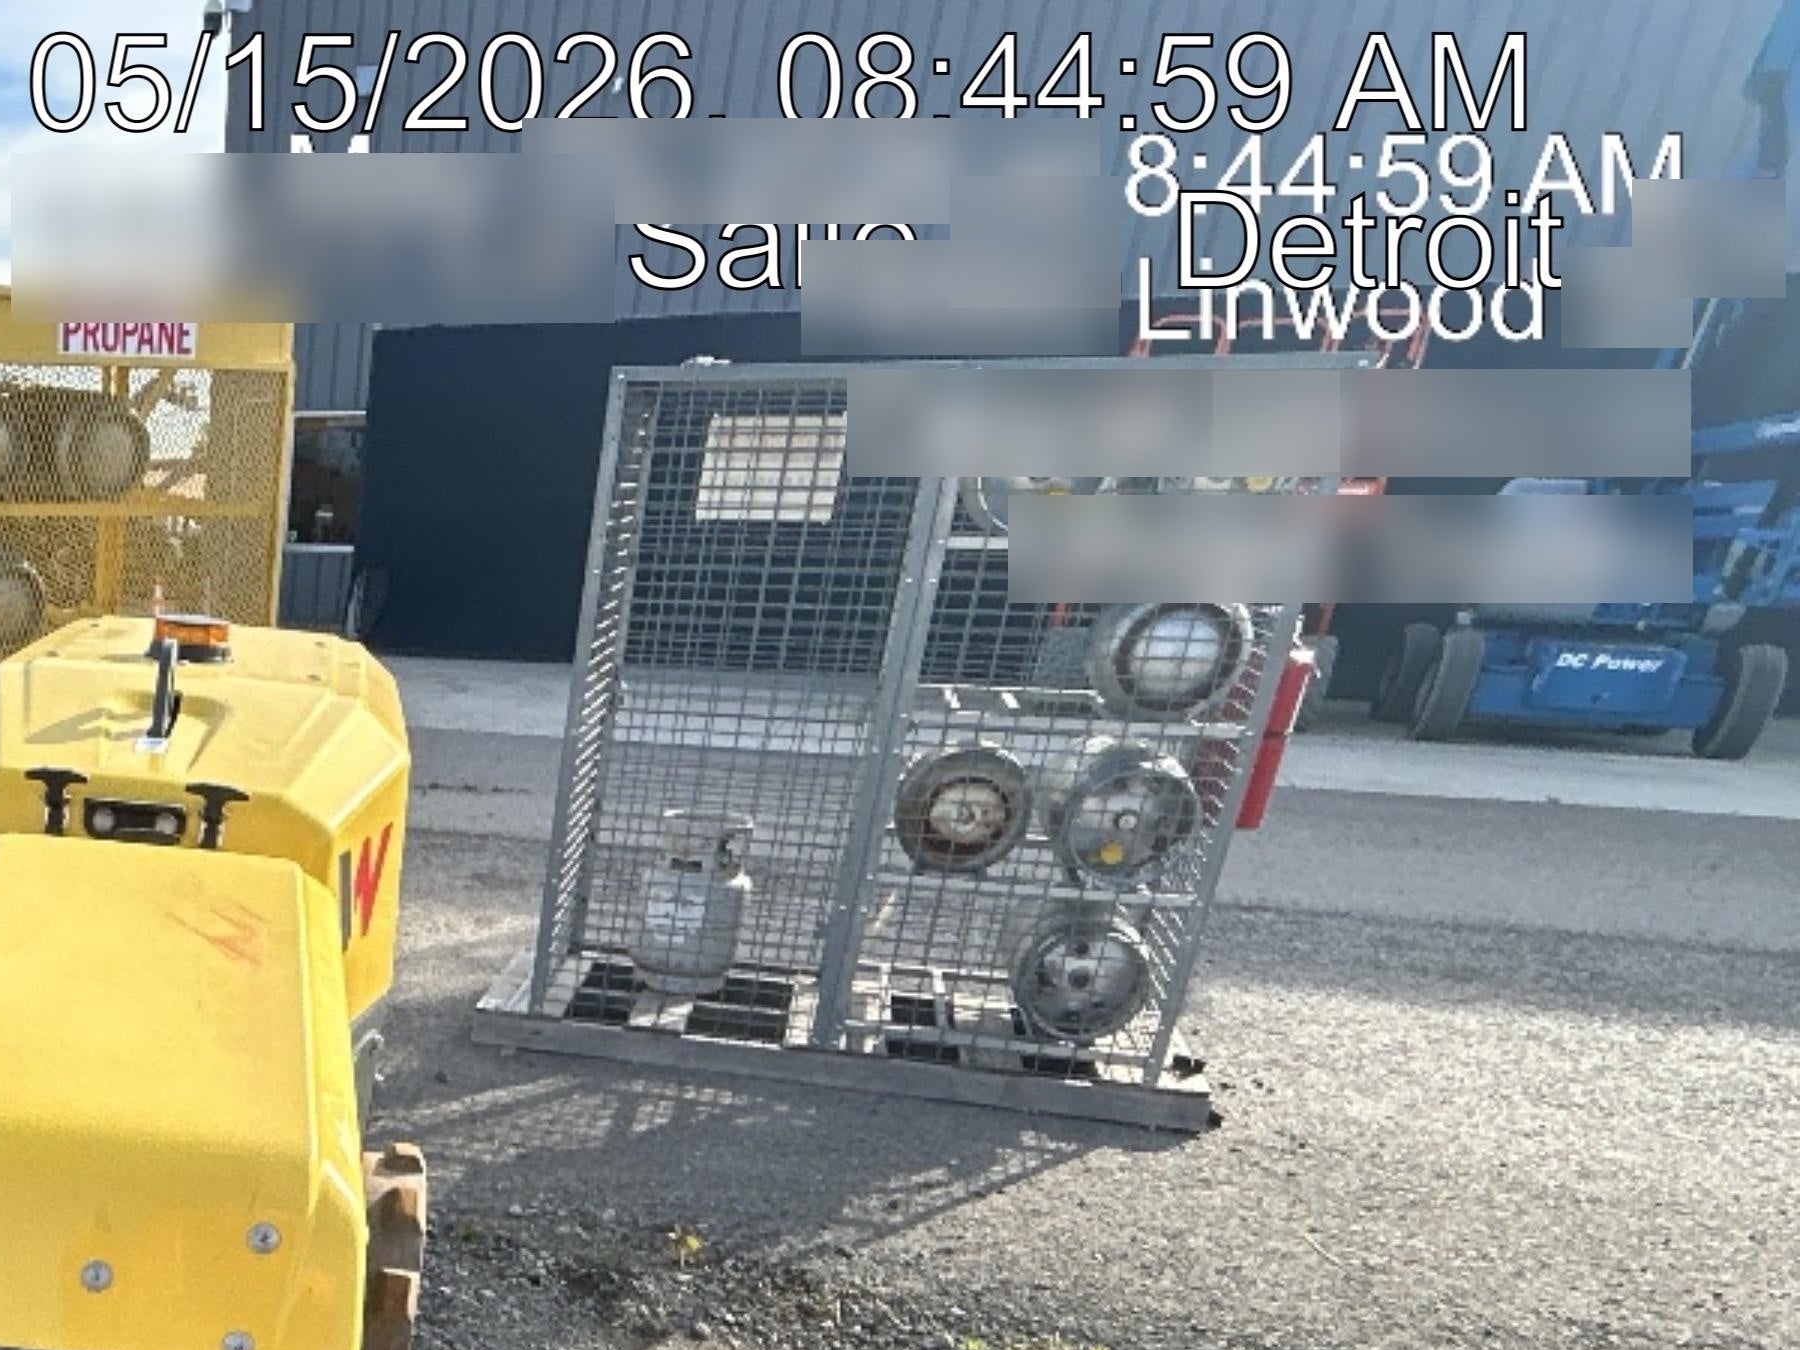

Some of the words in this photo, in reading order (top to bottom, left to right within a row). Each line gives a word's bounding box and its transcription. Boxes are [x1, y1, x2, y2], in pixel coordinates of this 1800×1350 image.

[62, 322, 192, 355] PROPANE
[1554, 652, 1588, 670] DC
[1590, 652, 1665, 673] Power
